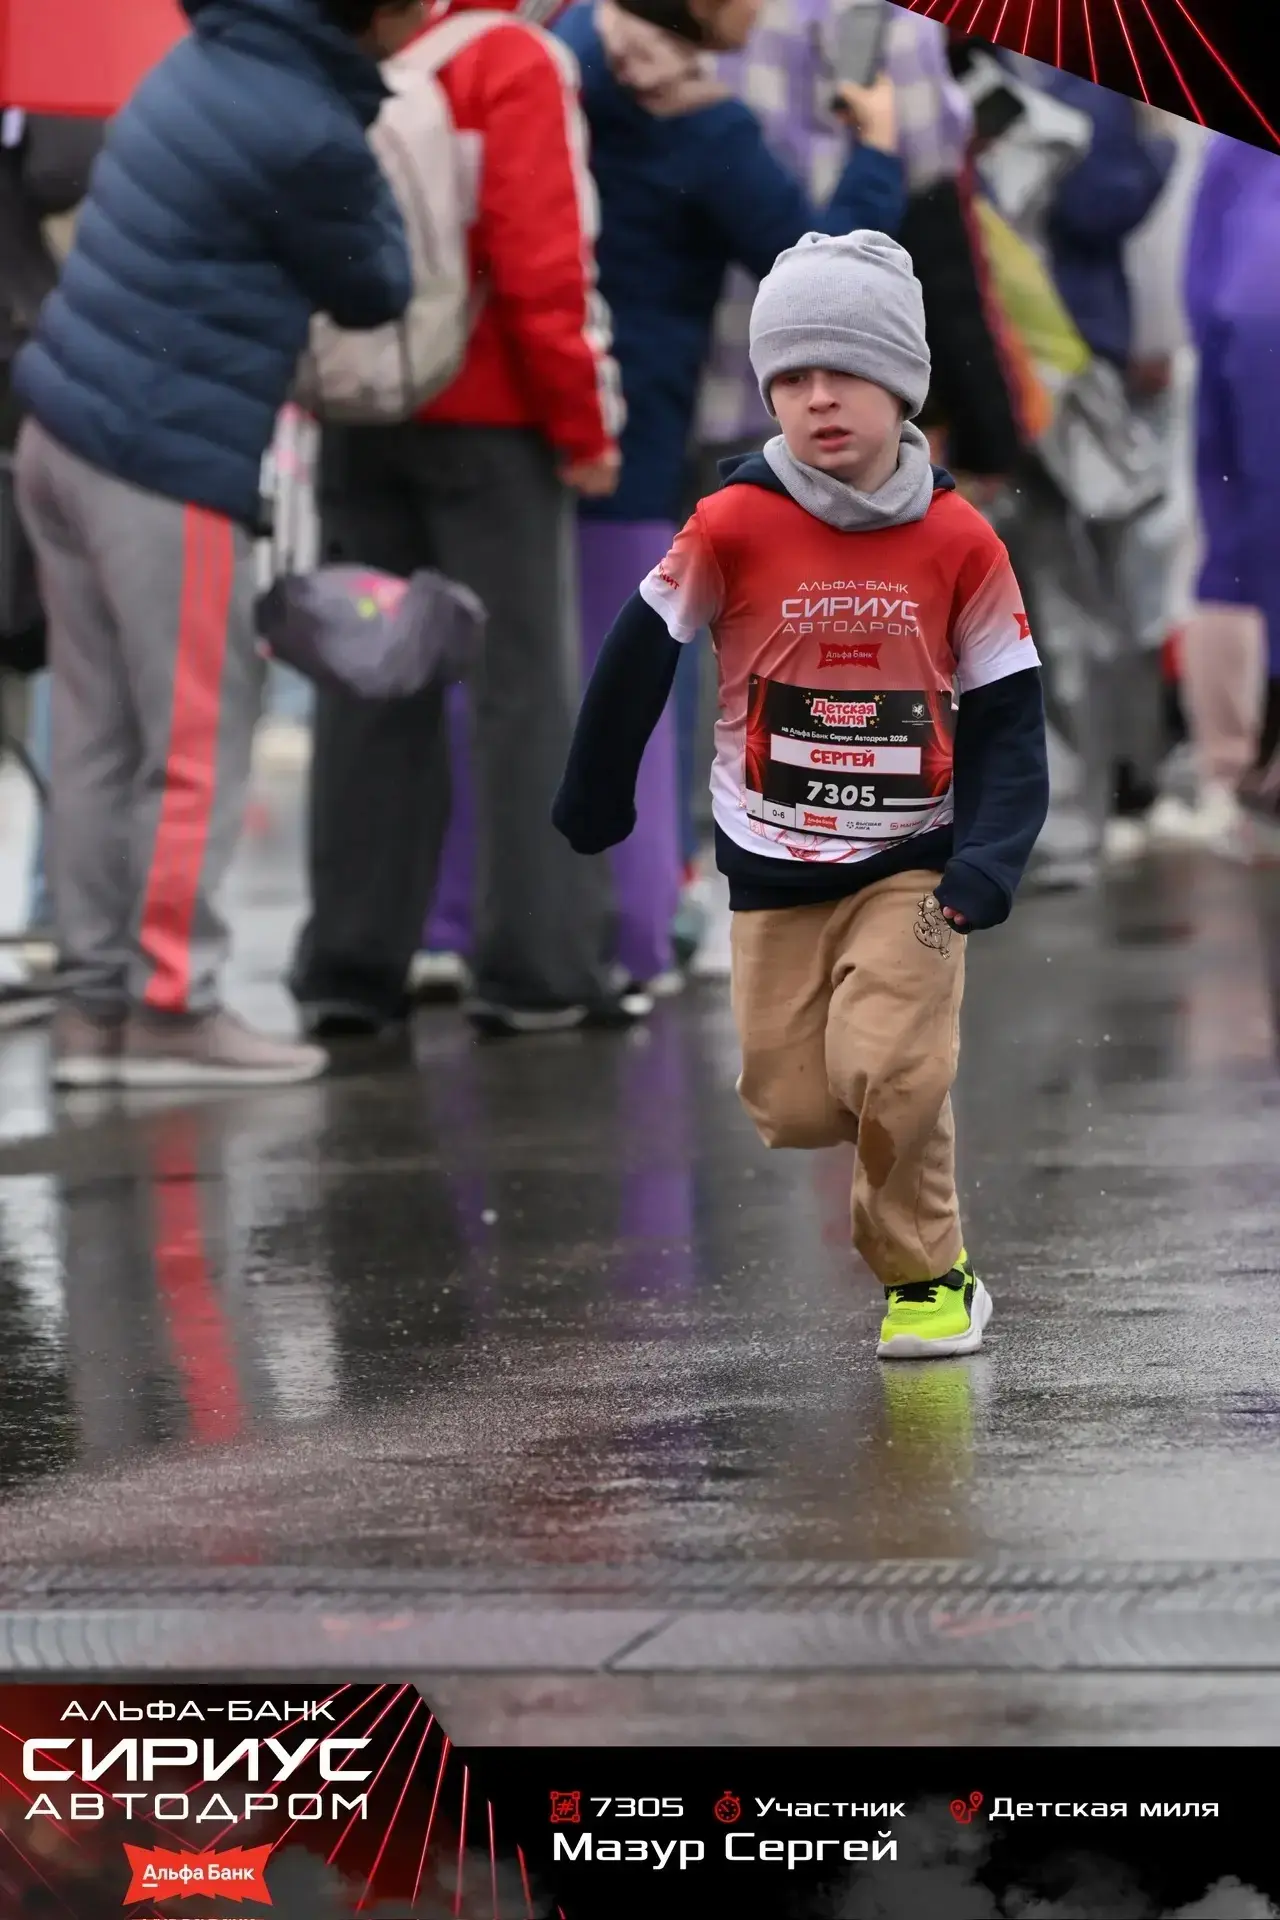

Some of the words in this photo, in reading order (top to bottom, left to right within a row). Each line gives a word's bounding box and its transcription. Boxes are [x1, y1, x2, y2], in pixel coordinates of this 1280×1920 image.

[797, 580, 909, 594] АЛЬФА-БАНК
[781, 596, 920, 621] СИРИУС
[782, 620, 920, 638] АВТОДРОМ
[825, 650, 852, 661] Альфа
[852, 650, 873, 658] Банк
[812, 700, 875, 716] Детская
[789, 728, 811, 738] Альфа
[811, 731, 828, 740] Банк
[829, 733, 853, 742] Сириус
[854, 734, 888, 743] Автодром
[889, 735, 908, 743] 2026
[810, 749, 875, 768] СЕРГЕЙ
[806, 780, 876, 807] 7305
